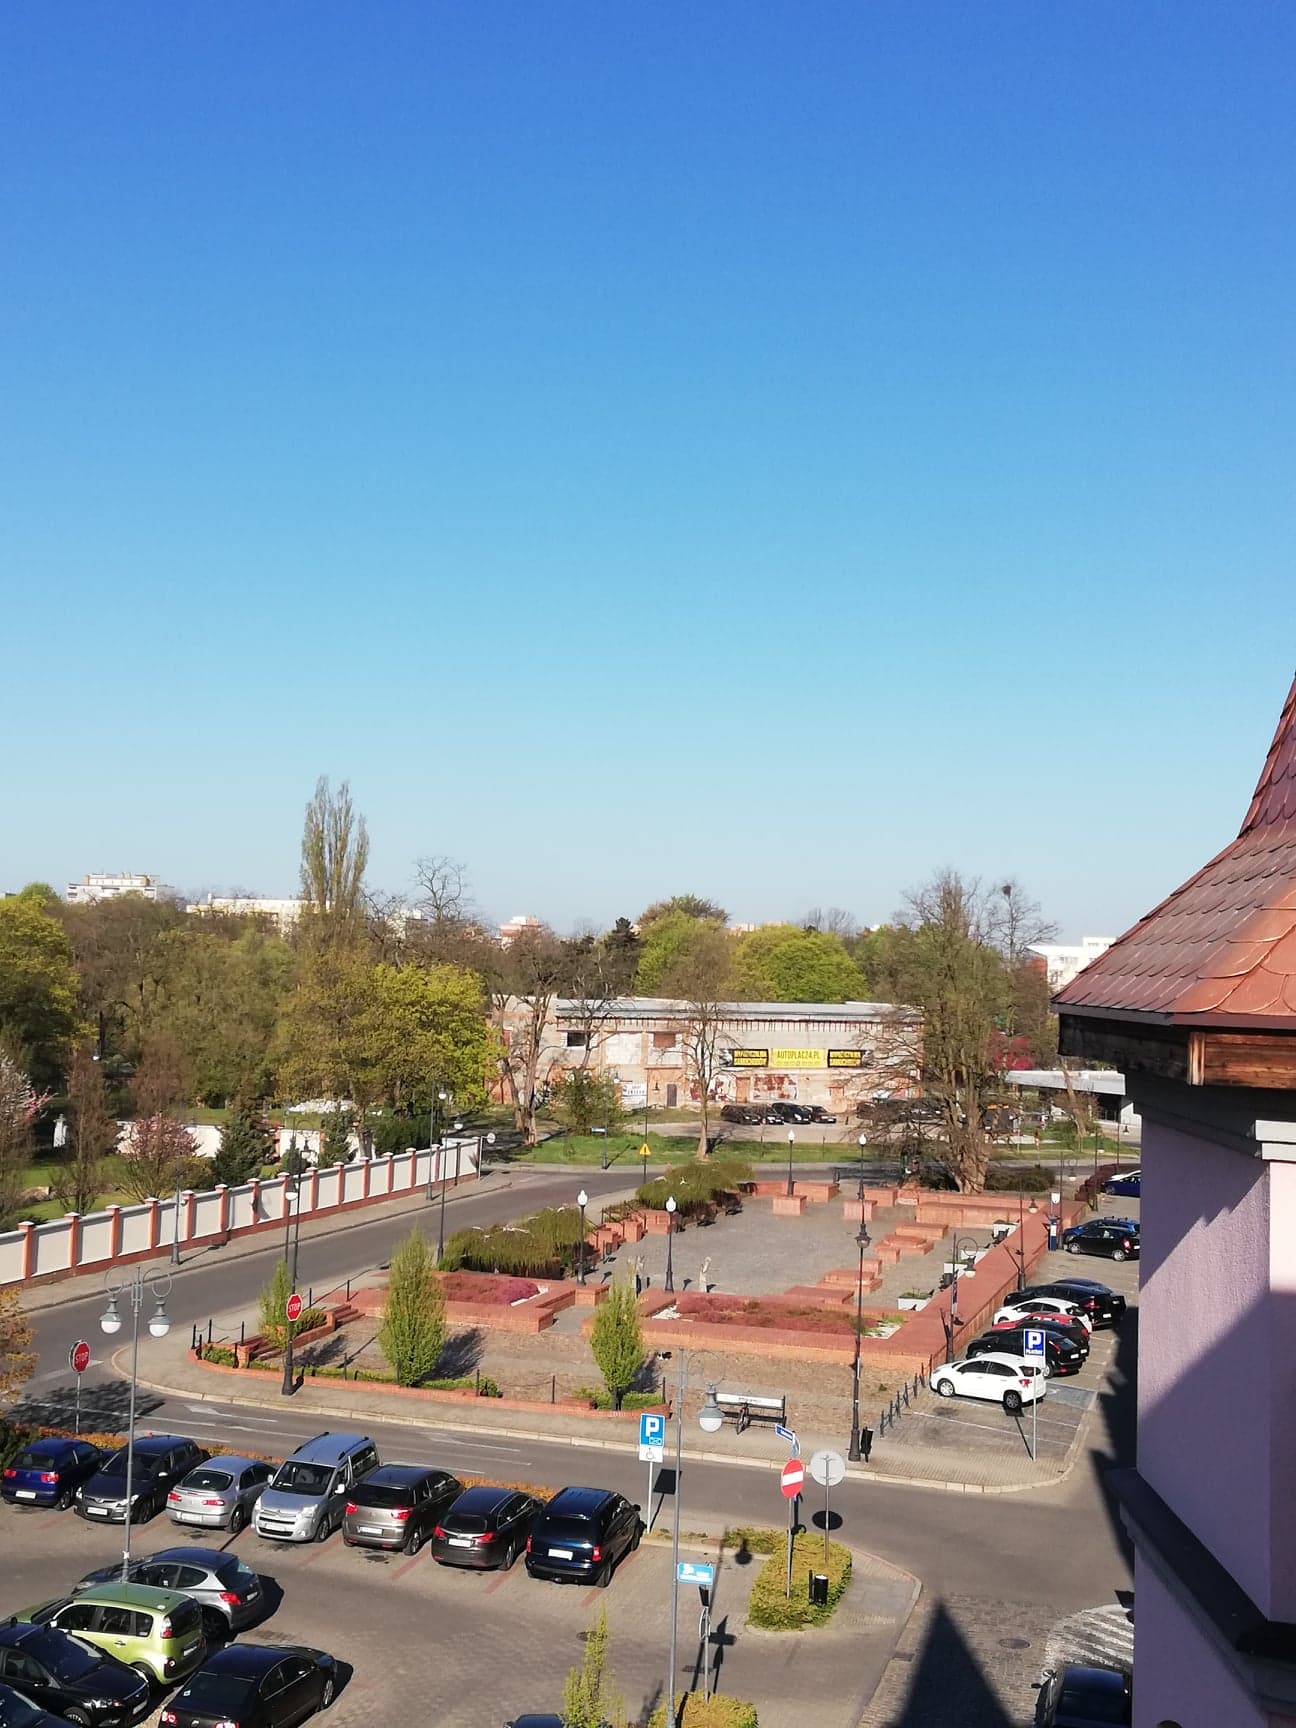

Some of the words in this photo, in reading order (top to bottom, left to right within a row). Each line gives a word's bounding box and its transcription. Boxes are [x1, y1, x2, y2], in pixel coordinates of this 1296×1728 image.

[288, 1302, 301, 1313] STOP
[1028, 1332, 1042, 1349] P
[75, 1350, 89, 1364] STOP
[645, 1416, 660, 1437] P
